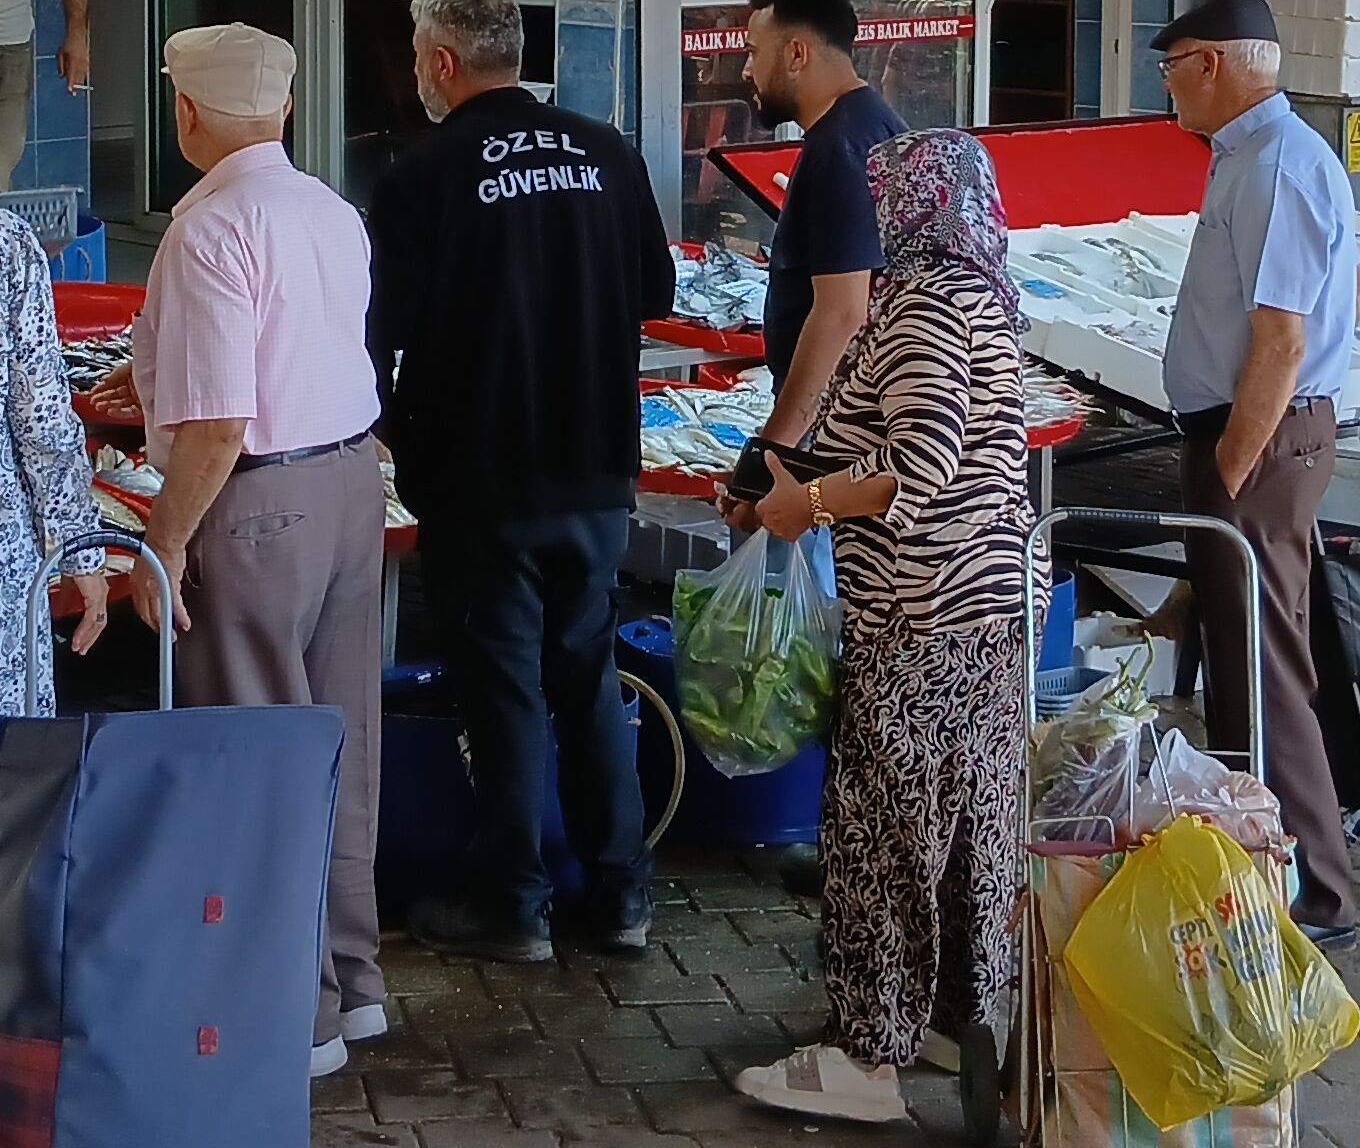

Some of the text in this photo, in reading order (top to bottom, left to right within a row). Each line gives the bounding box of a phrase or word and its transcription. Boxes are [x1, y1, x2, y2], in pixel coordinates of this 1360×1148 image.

[877, 22, 911, 39] BALIK
[914, 19, 959, 37] MARKET
[684, 32, 724, 52] BALIK
[482, 130, 586, 163] ÖZEL
